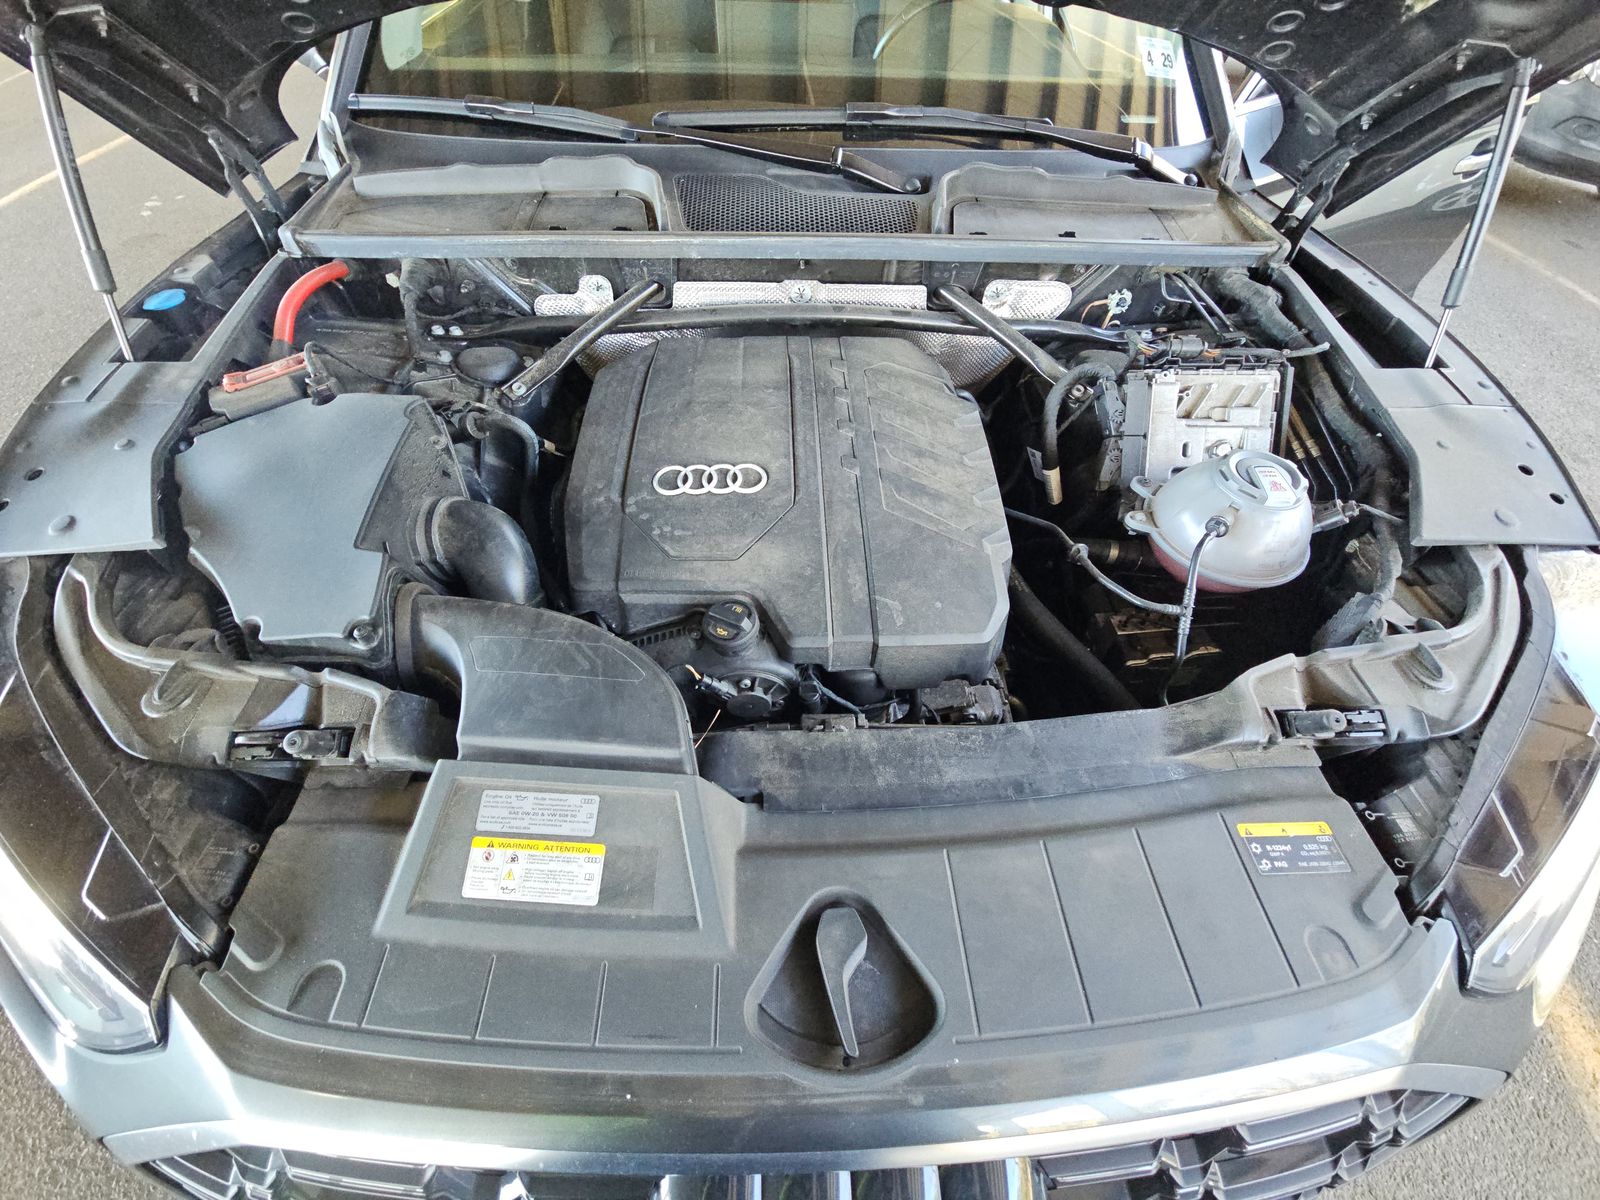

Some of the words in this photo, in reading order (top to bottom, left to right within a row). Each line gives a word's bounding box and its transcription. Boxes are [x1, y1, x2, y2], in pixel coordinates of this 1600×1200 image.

[1147, 50, 1154, 66] 4
[1161, 52, 1174, 69] 29
[498, 842, 539, 851] WARNING
[543, 843, 591, 854] ATTENTION
